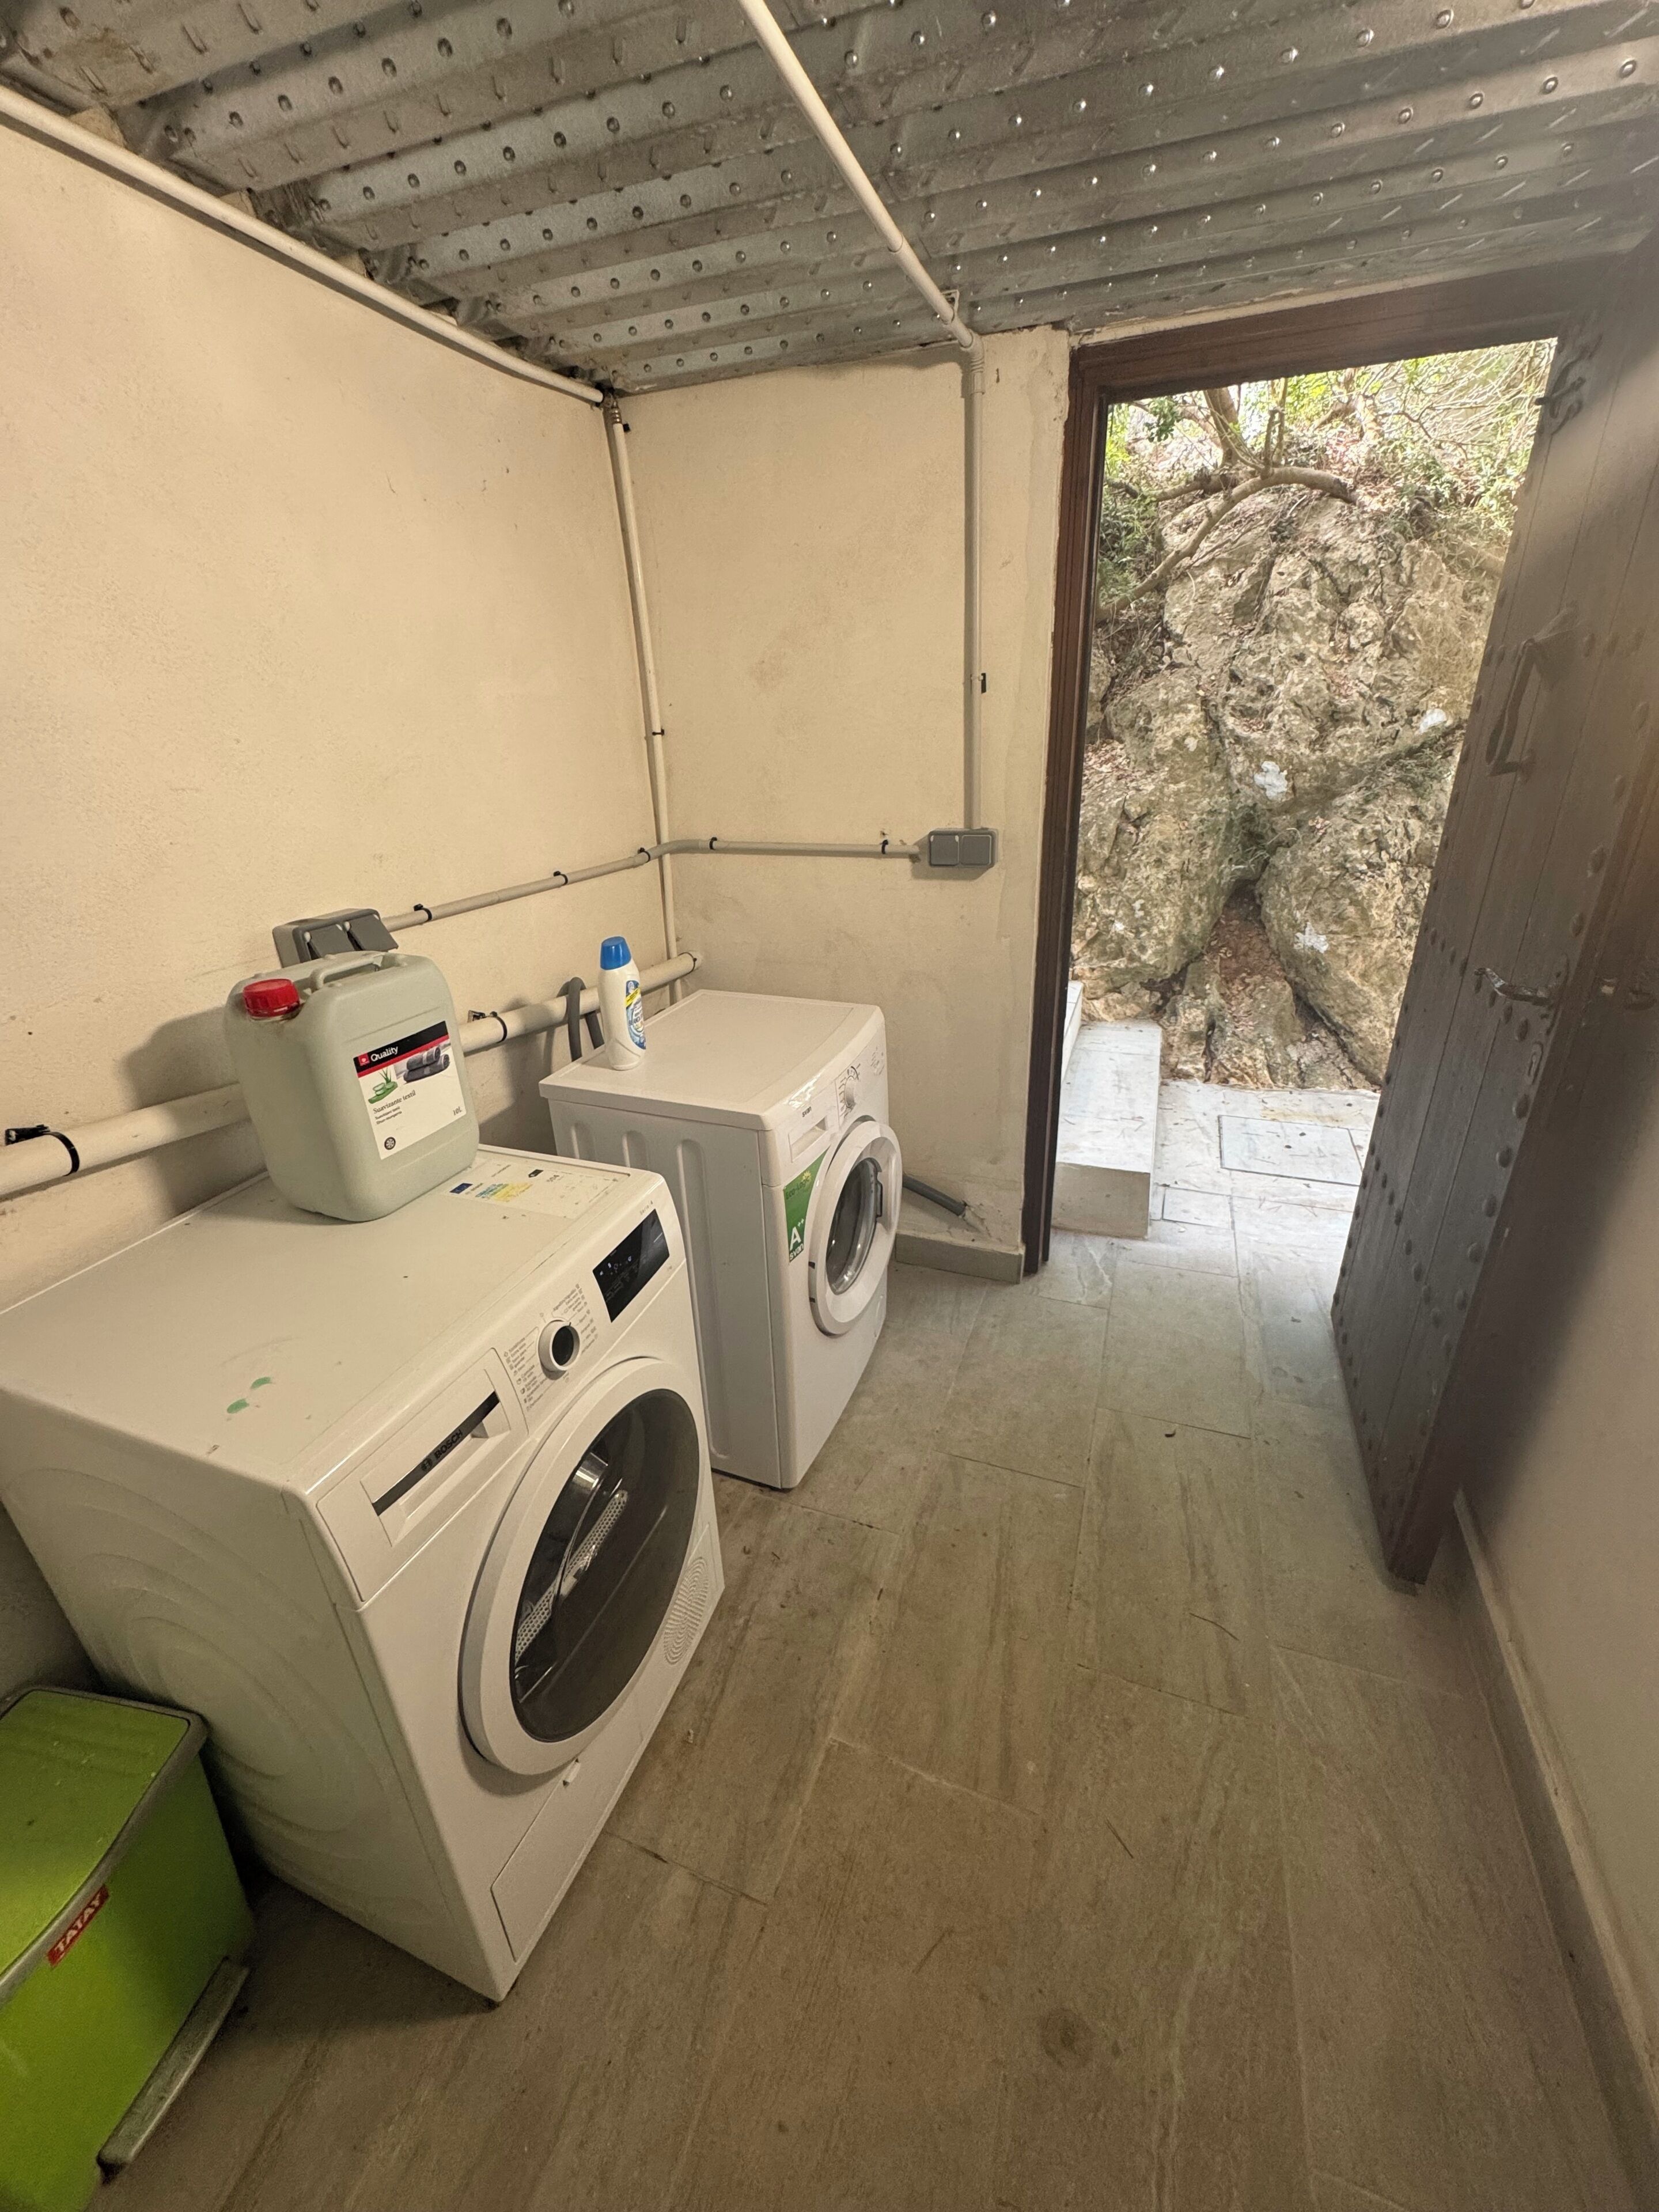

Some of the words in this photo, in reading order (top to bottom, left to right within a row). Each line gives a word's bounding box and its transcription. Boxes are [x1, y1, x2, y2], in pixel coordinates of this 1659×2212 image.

[370, 1046, 399, 1062] Quality
[373, 1098, 402, 1114] Suavizante
[403, 1089, 416, 1101] textil
[453, 1106, 463, 1116] 10L
[802, 1106, 812, 1118] svan
[789, 1243, 804, 1260] svan
[434, 1429, 463, 1459] BOSCH
[54, 1892, 101, 1952] TATAY
